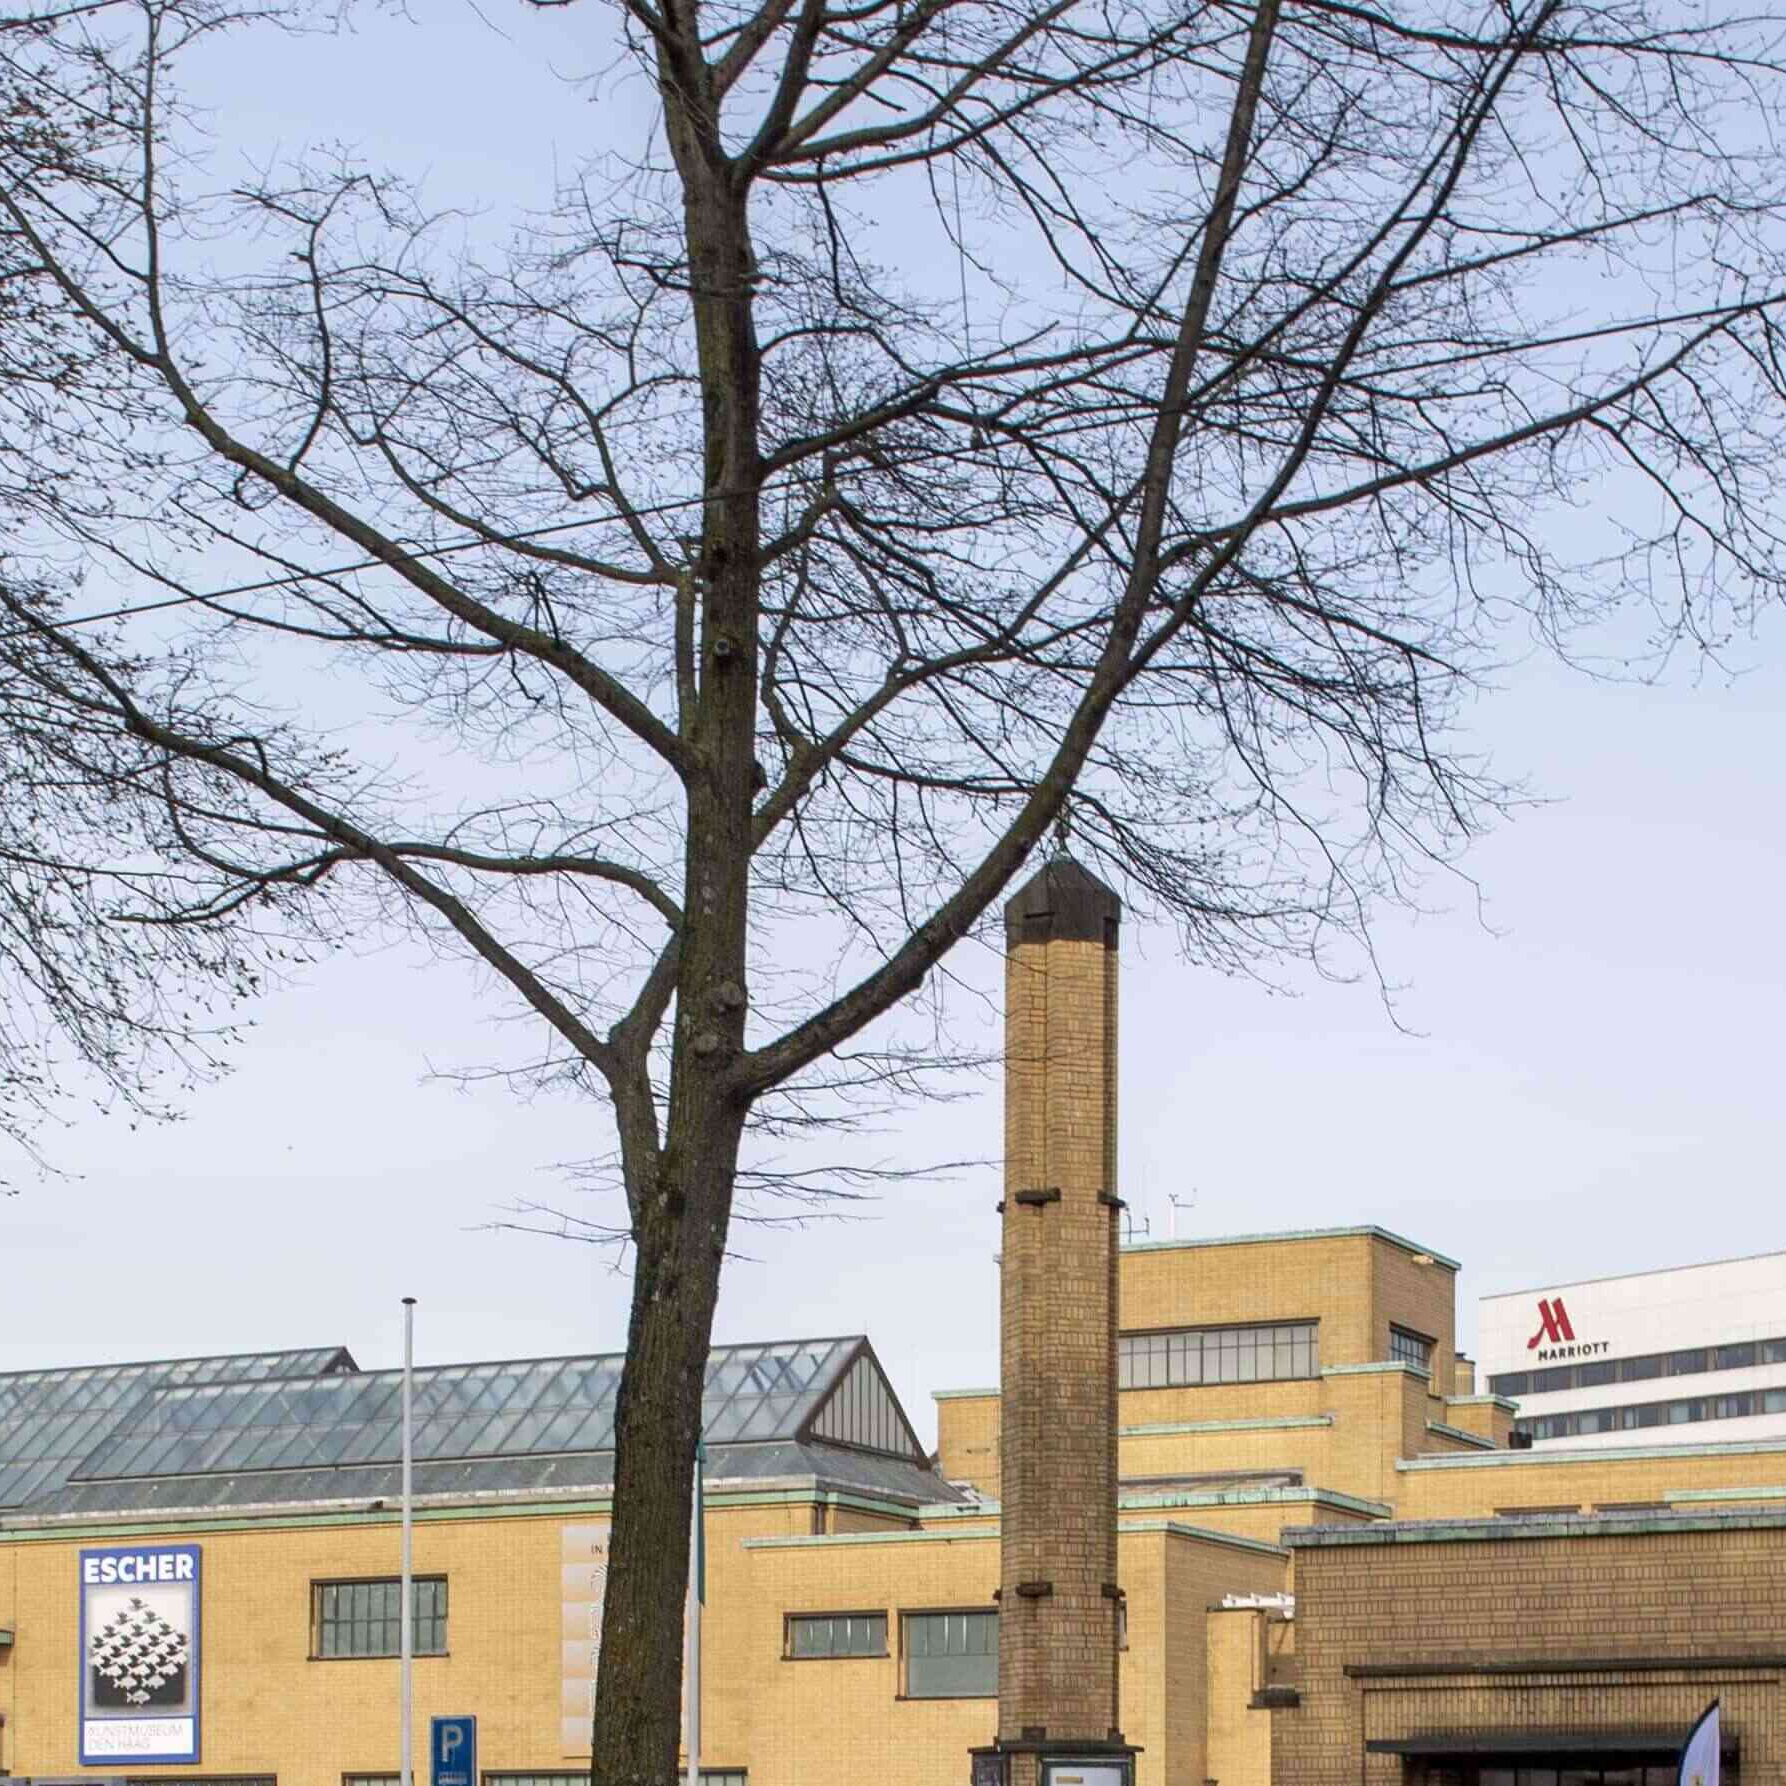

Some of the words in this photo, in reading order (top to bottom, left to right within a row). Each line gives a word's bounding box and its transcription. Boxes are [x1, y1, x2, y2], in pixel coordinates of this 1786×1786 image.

[1538, 1341, 1609, 1361] MARRIOTT
[84, 1554, 194, 1583] ESCHER
[441, 1724, 464, 1762] P
